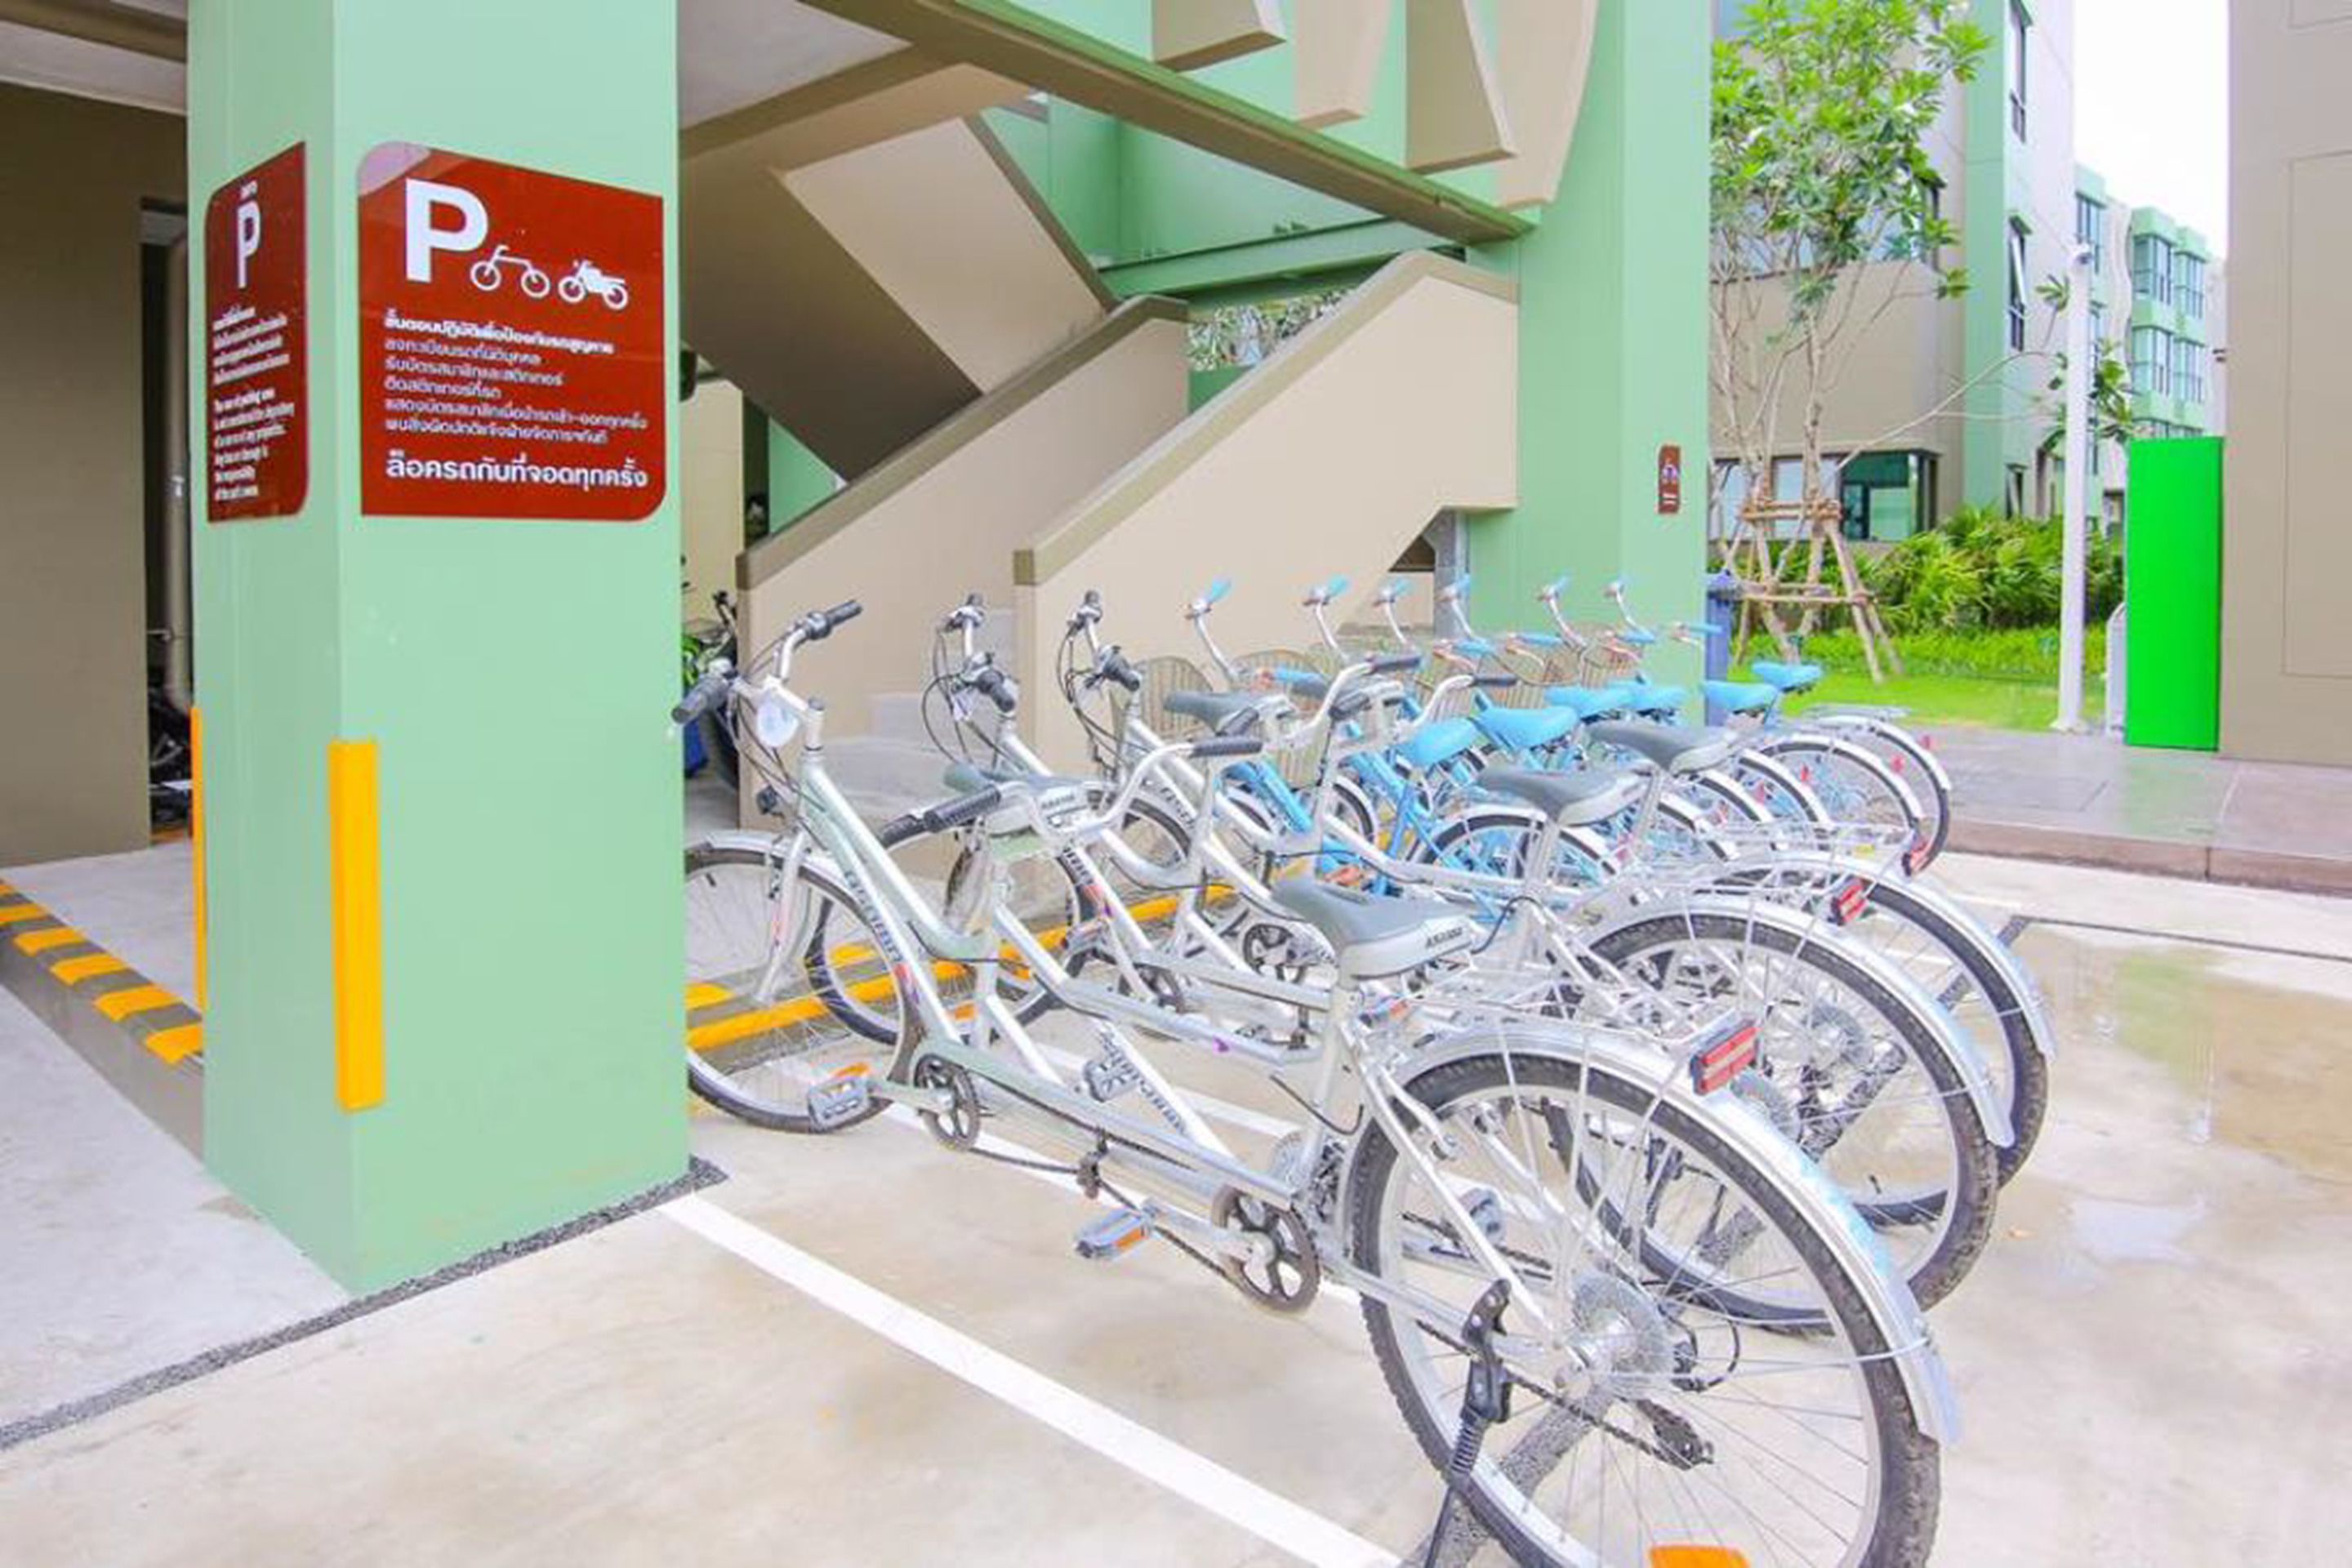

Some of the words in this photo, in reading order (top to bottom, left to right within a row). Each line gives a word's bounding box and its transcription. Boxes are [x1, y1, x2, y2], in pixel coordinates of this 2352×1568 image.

[238, 202, 260, 288] P
[405, 178, 489, 283] P
[385, 448, 648, 492] ล็อครถกับที่จอดทุกครั้ง
